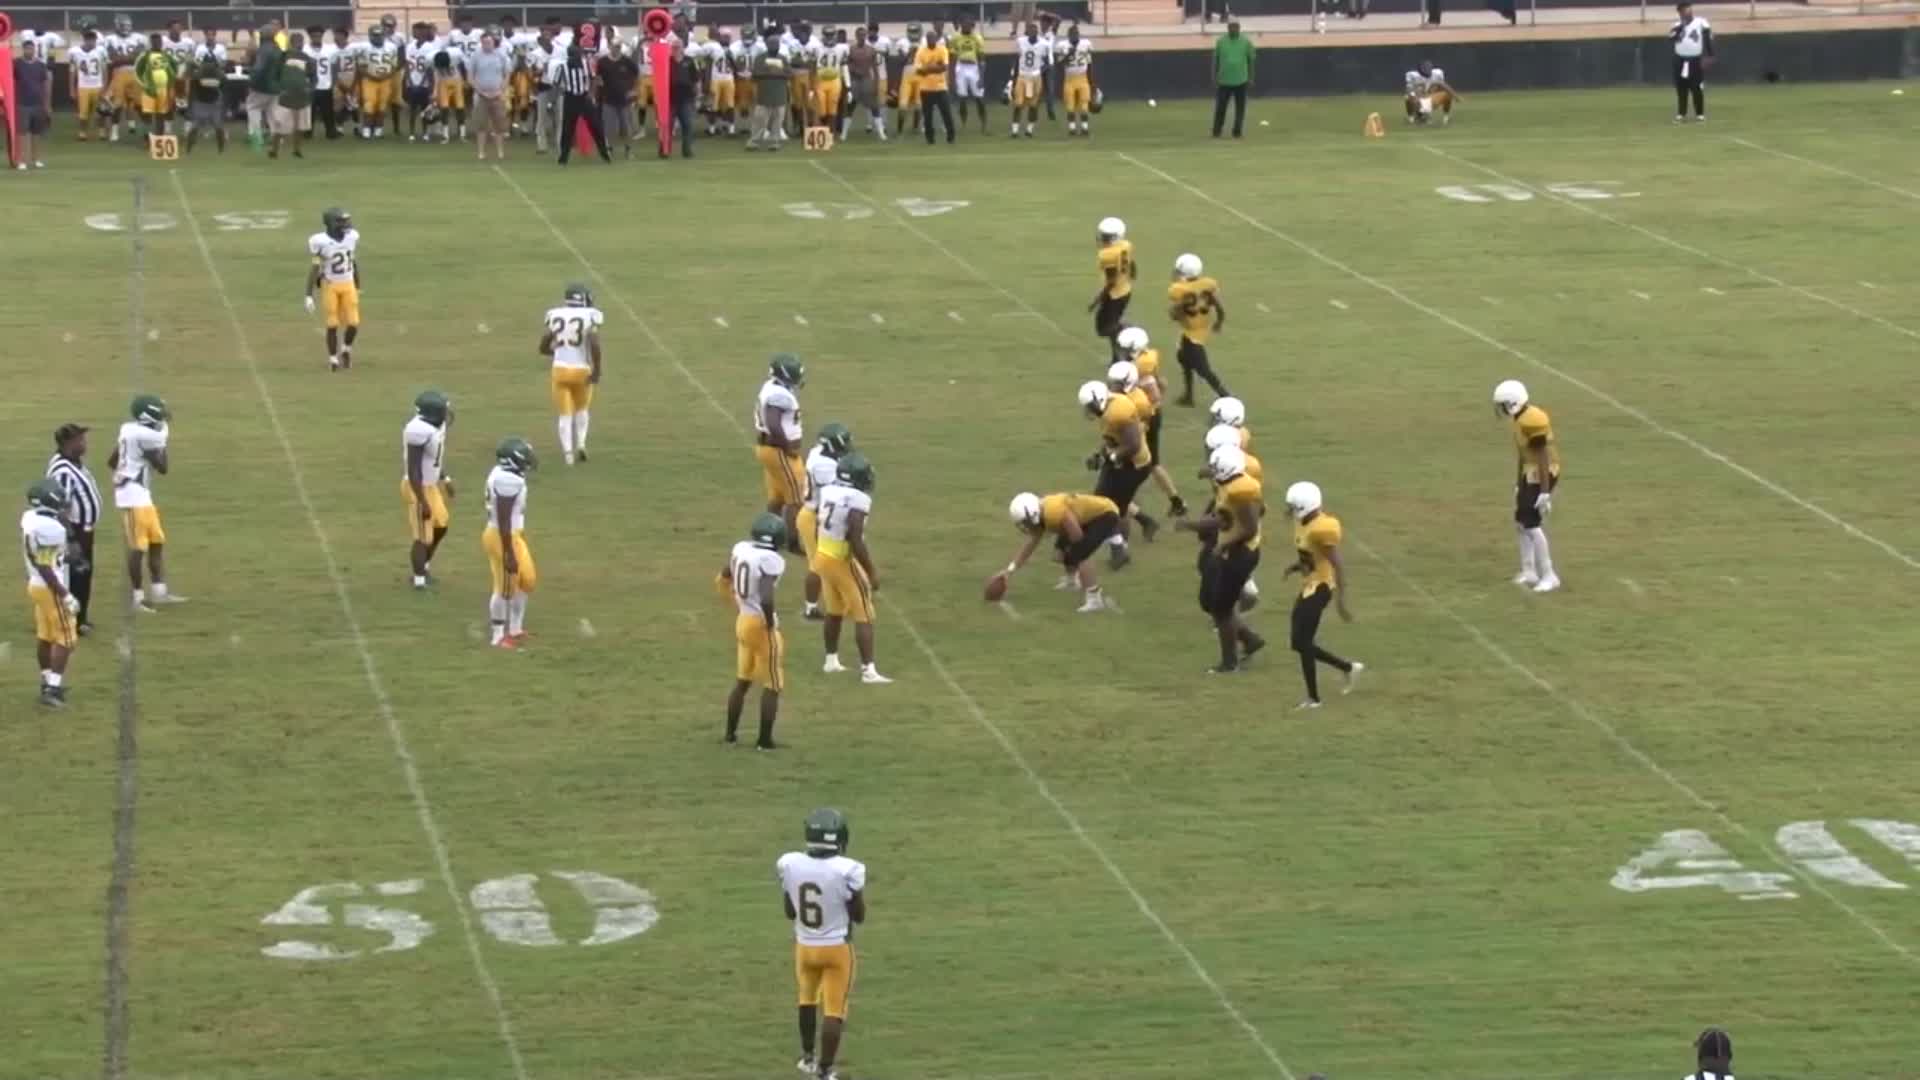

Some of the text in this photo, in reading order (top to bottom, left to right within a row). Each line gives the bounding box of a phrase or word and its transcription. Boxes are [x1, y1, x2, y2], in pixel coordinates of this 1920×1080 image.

[579, 23, 596, 48] 2
[79, 58, 100, 76] 43
[1025, 51, 1036, 68] 8
[154, 139, 175, 158] 50
[806, 130, 827, 149] 40
[331, 252, 353, 275] 21
[551, 316, 583, 348] 23
[1609, 818, 1920, 900] 40
[260, 870, 660, 960] 50
[798, 882, 823, 929] 6
